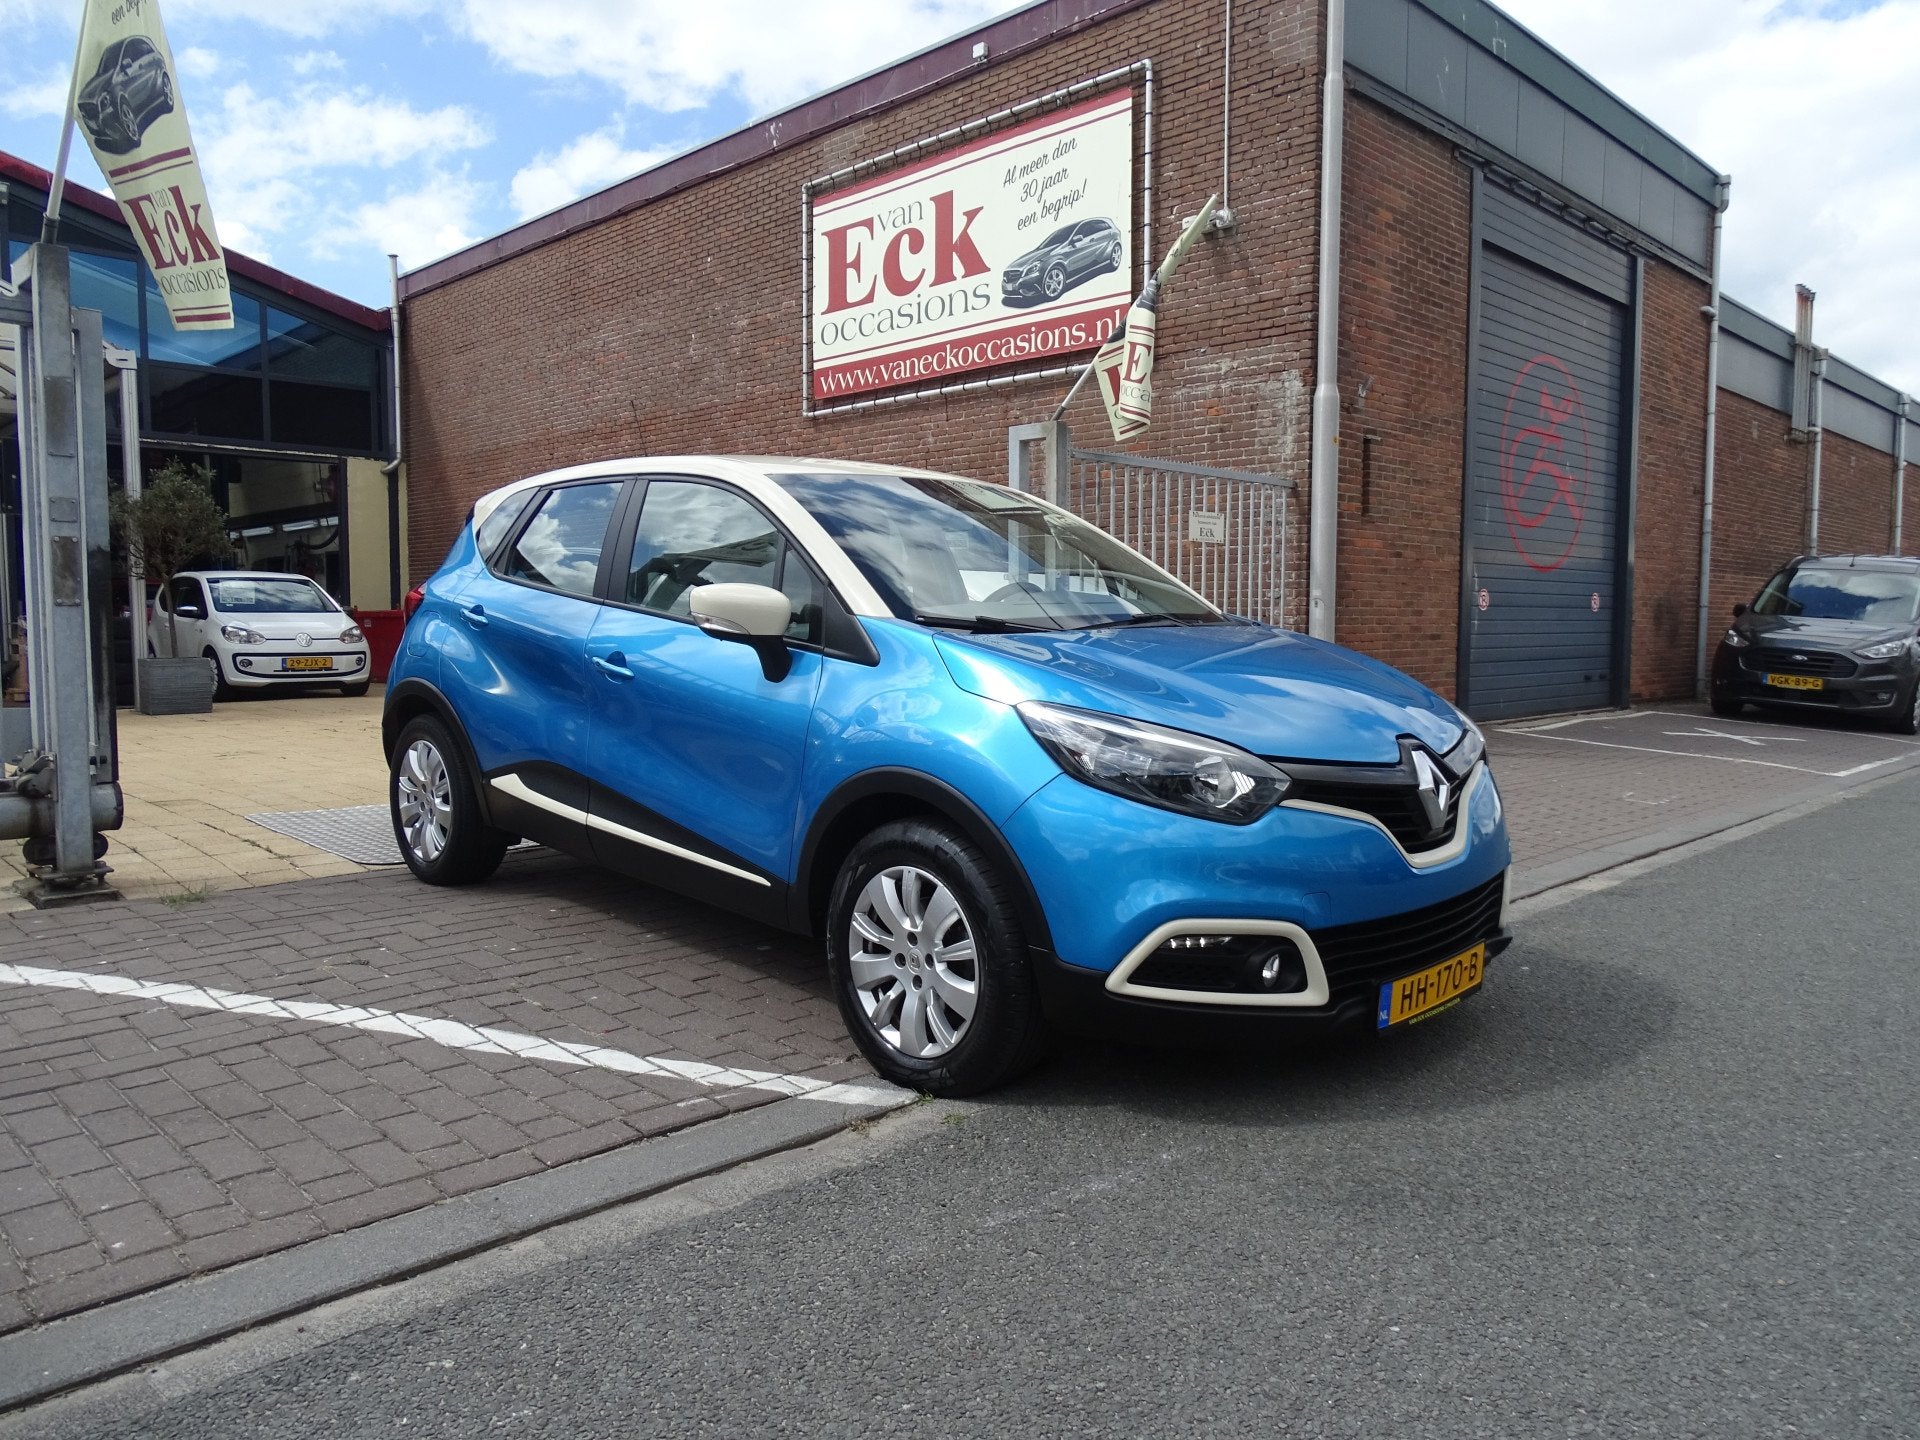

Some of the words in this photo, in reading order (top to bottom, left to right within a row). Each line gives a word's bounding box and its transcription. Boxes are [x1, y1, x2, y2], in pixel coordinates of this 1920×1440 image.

[1003, 165, 1017, 187] Al
[1019, 153, 1049, 179] meer
[1052, 138, 1077, 160] dan
[1020, 179, 1038, 202] 30
[1037, 168, 1069, 203] jaar
[123, 185, 221, 270] Eck
[877, 200, 924, 233] van
[1017, 211, 1038, 230] een
[1041, 178, 1087, 222] begrip!
[821, 190, 991, 316] Eck
[160, 266, 227, 295] occasions
[820, 282, 992, 346] occasions
[820, 309, 1120, 394] www.vaneckoccasions.nl
[289, 658, 327, 667] 29-ZJX-2
[1770, 675, 1820, 688] VGK-89-G
[1400, 951, 1479, 1015] HH-170-B
